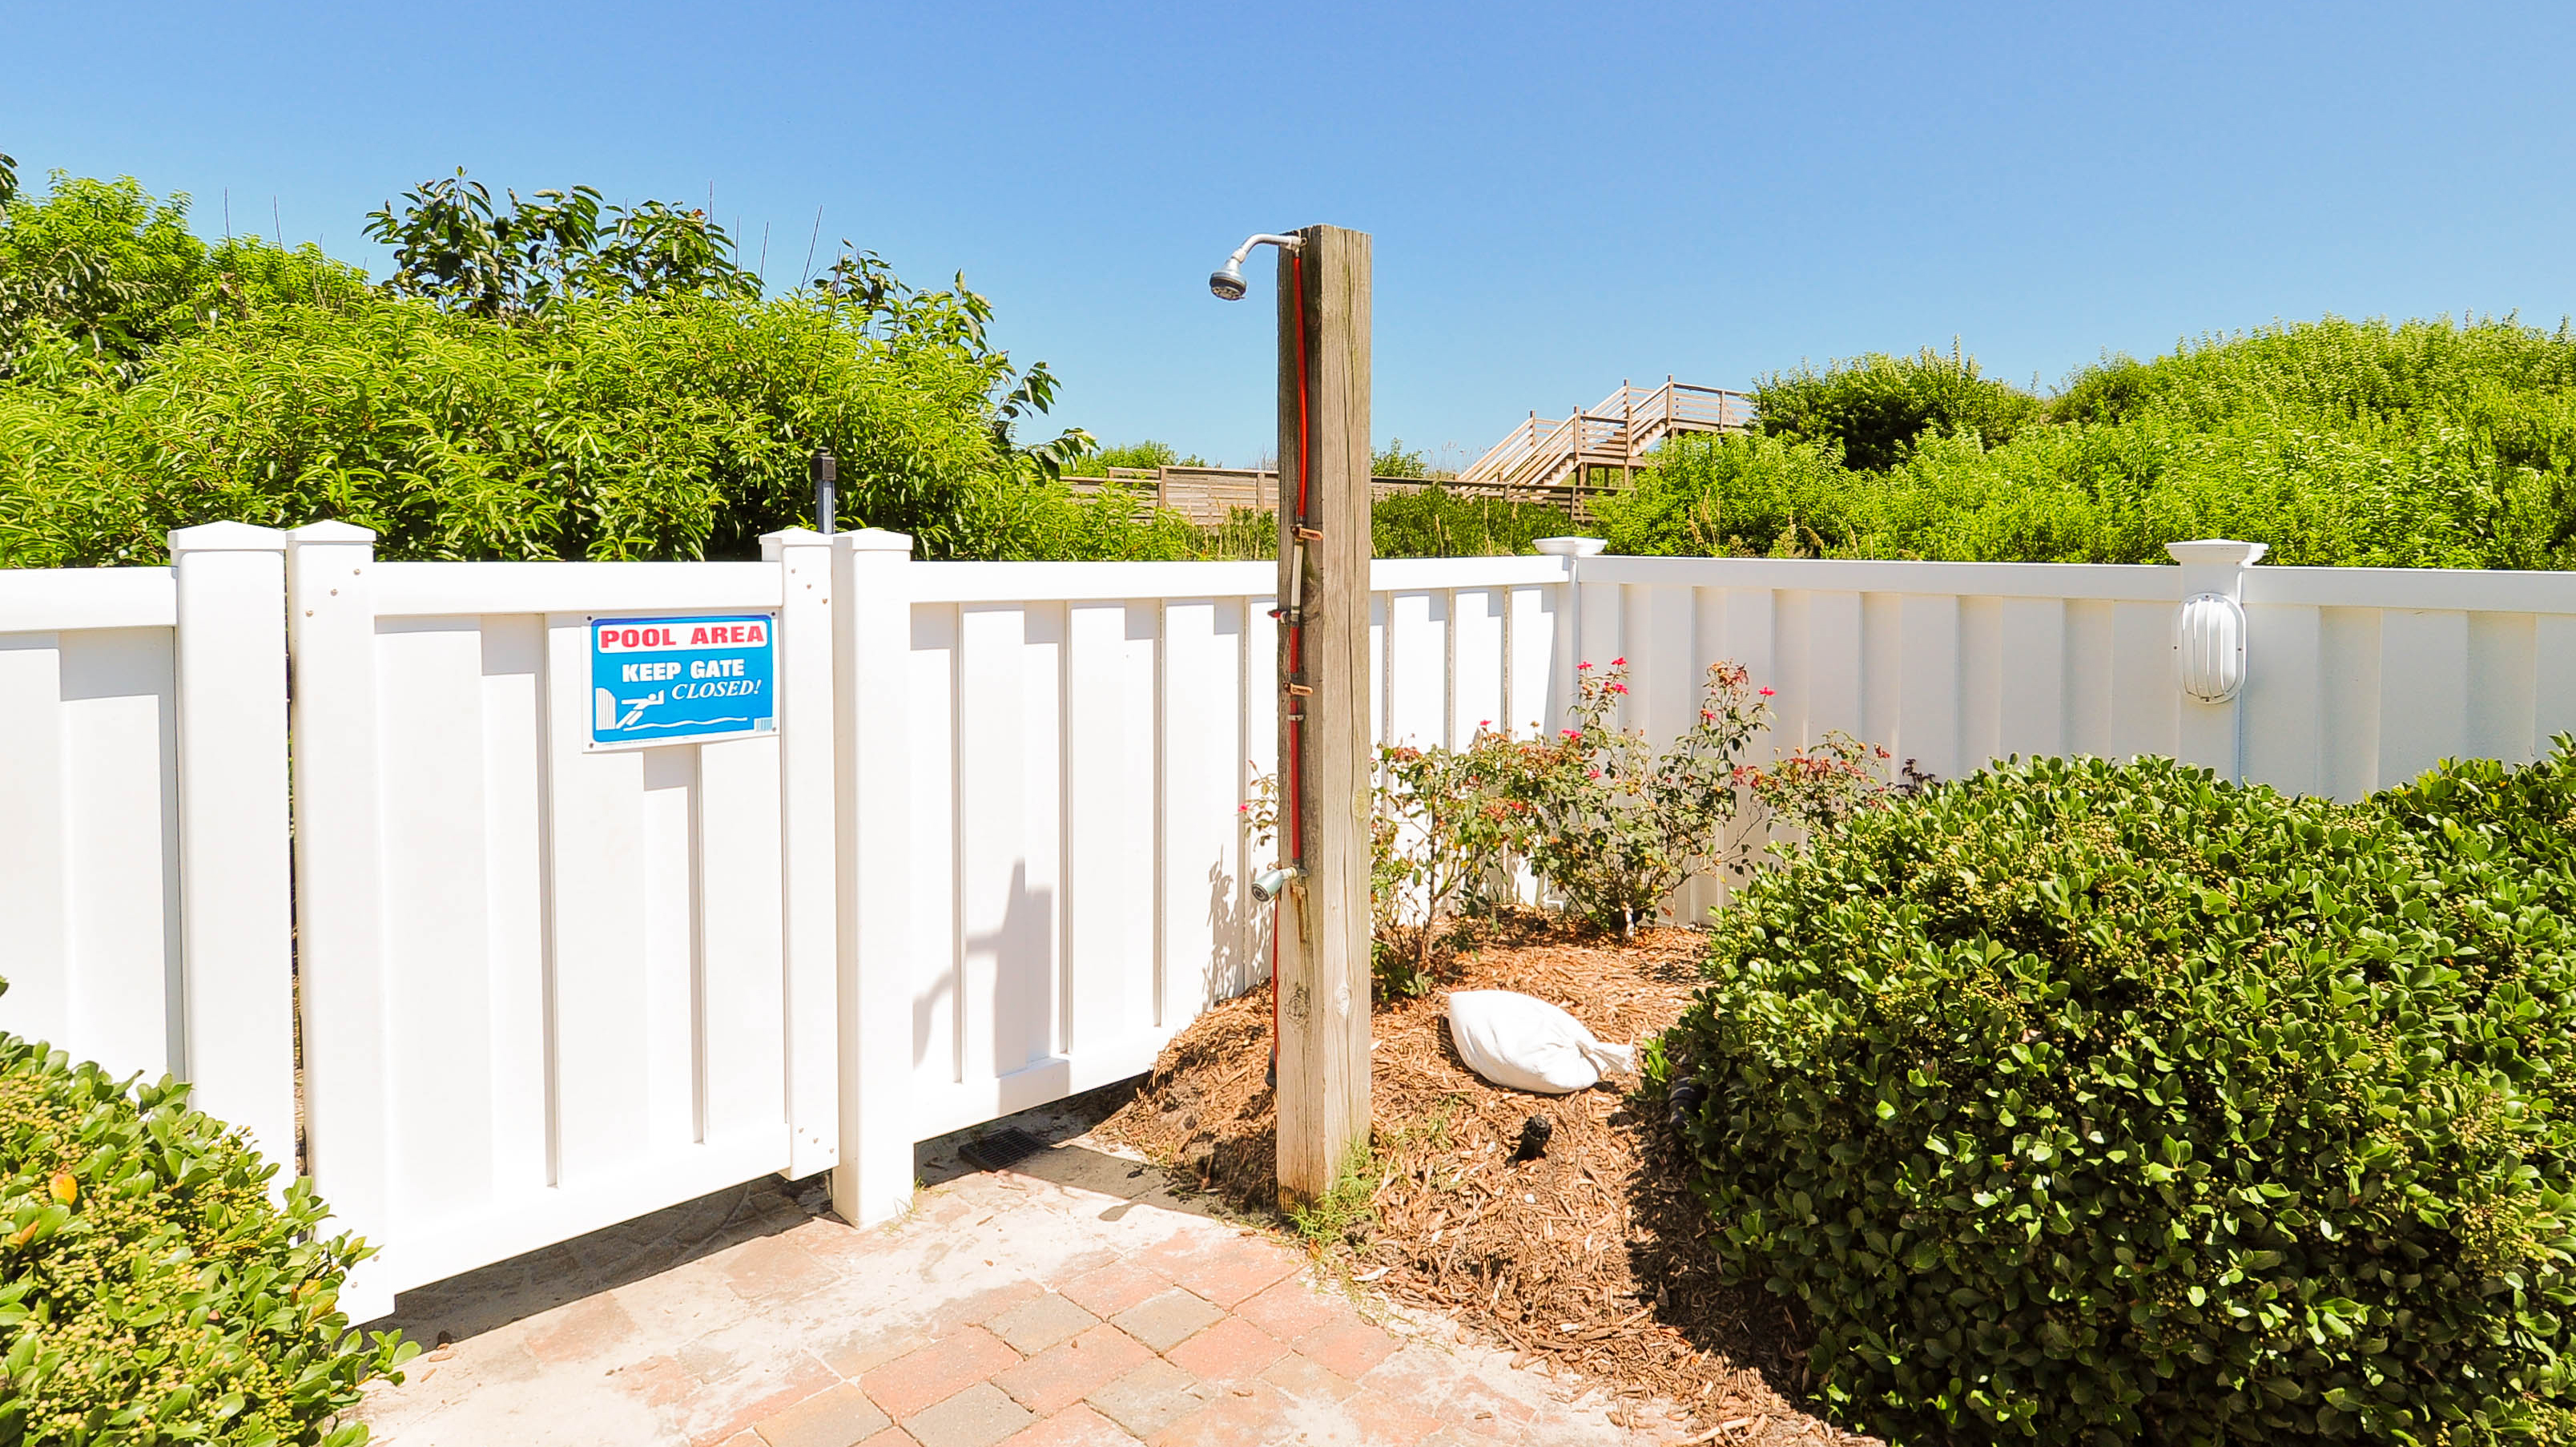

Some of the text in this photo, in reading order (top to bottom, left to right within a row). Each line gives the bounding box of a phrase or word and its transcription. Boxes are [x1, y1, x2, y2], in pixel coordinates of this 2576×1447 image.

[601, 626, 764, 649] POOL AREA
[622, 659, 745, 683] KEEP GATE
[671, 679, 762, 700] CLOSED!
